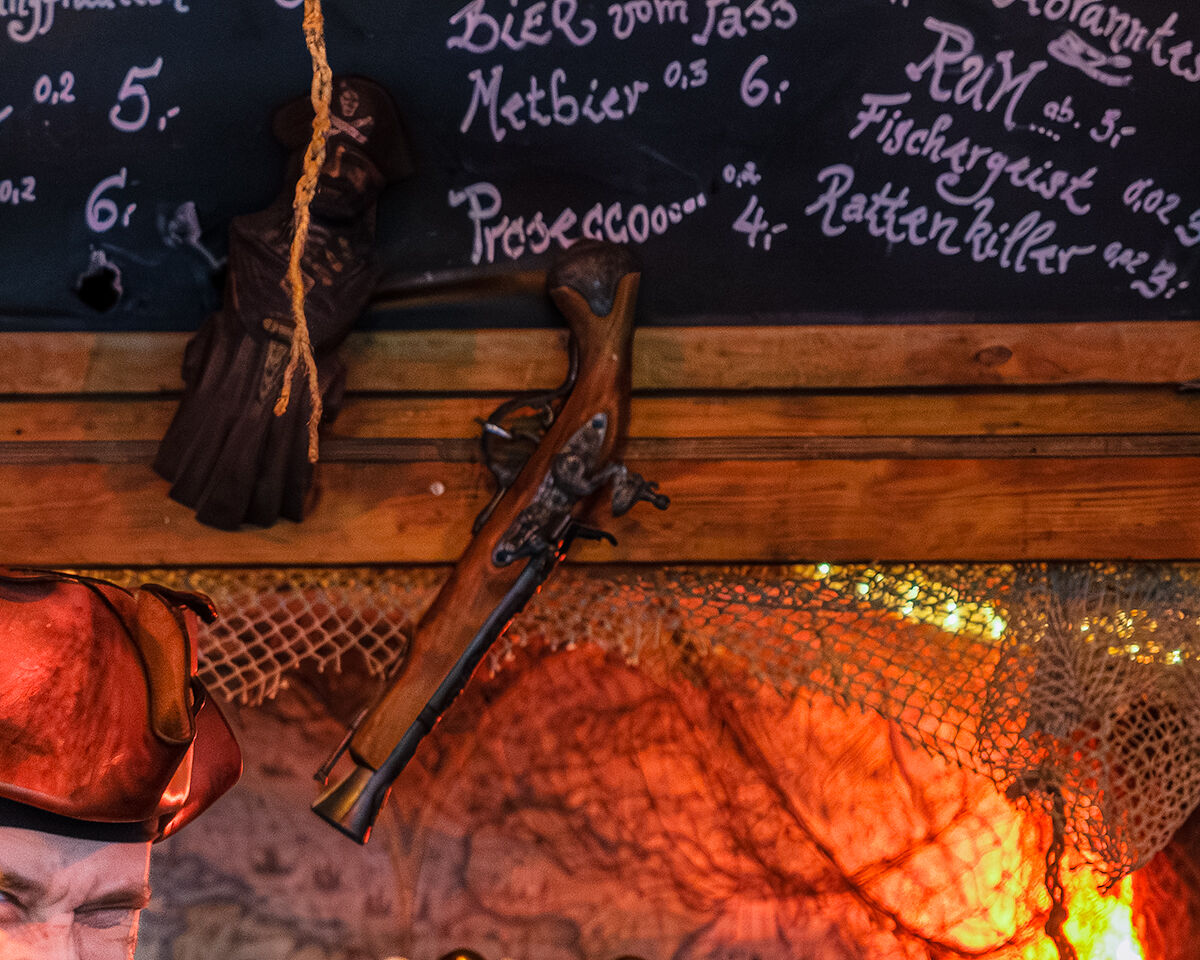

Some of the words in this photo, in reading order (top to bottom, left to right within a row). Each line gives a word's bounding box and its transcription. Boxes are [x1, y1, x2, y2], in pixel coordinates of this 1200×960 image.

[608, 0, 689, 40] vom
[33, 70, 76, 105] 0,2
[108, 56, 180, 132] 5,-
[460, 65, 650, 142] Metbier
[664, 58, 709, 90] 0,3
[848, 92, 1099, 215] Fischergeist
[731, 194, 788, 250] 4,-
